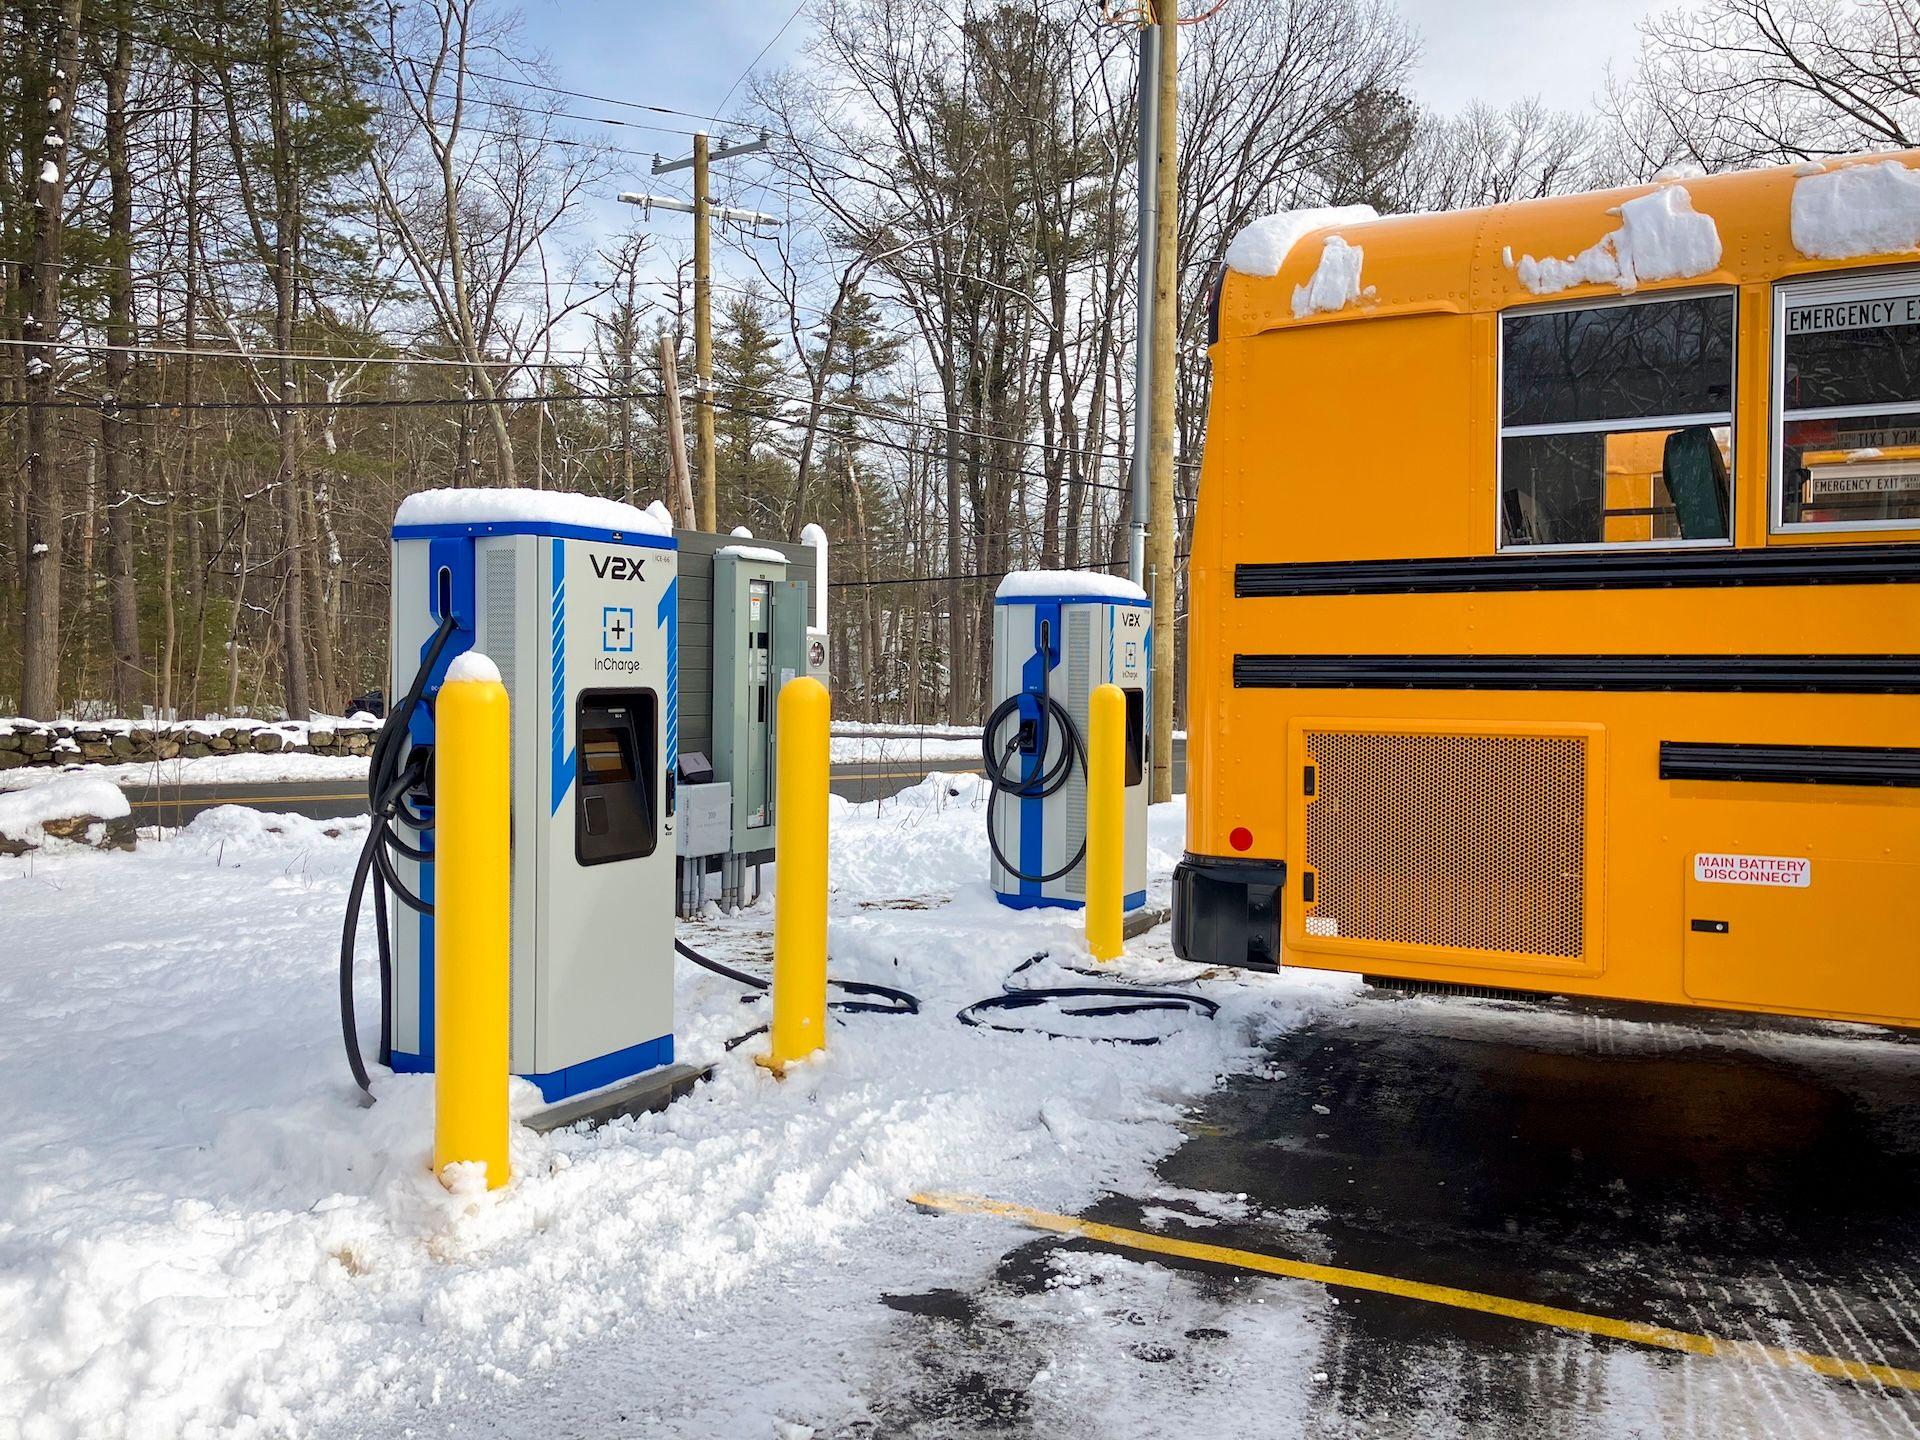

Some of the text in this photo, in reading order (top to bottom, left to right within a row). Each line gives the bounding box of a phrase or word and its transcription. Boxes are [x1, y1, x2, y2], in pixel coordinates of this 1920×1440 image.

[1790, 302, 1895, 331] EMERGENCY
[1814, 477, 1899, 493] EMERGENCY EXIT
[589, 553, 646, 582] V2X
[1121, 612, 1141, 628] V2X
[594, 657, 640, 675] InCharge
[1698, 856, 1807, 872] MAIN BATTERY
[1704, 868, 1801, 883] DISCONNECT
